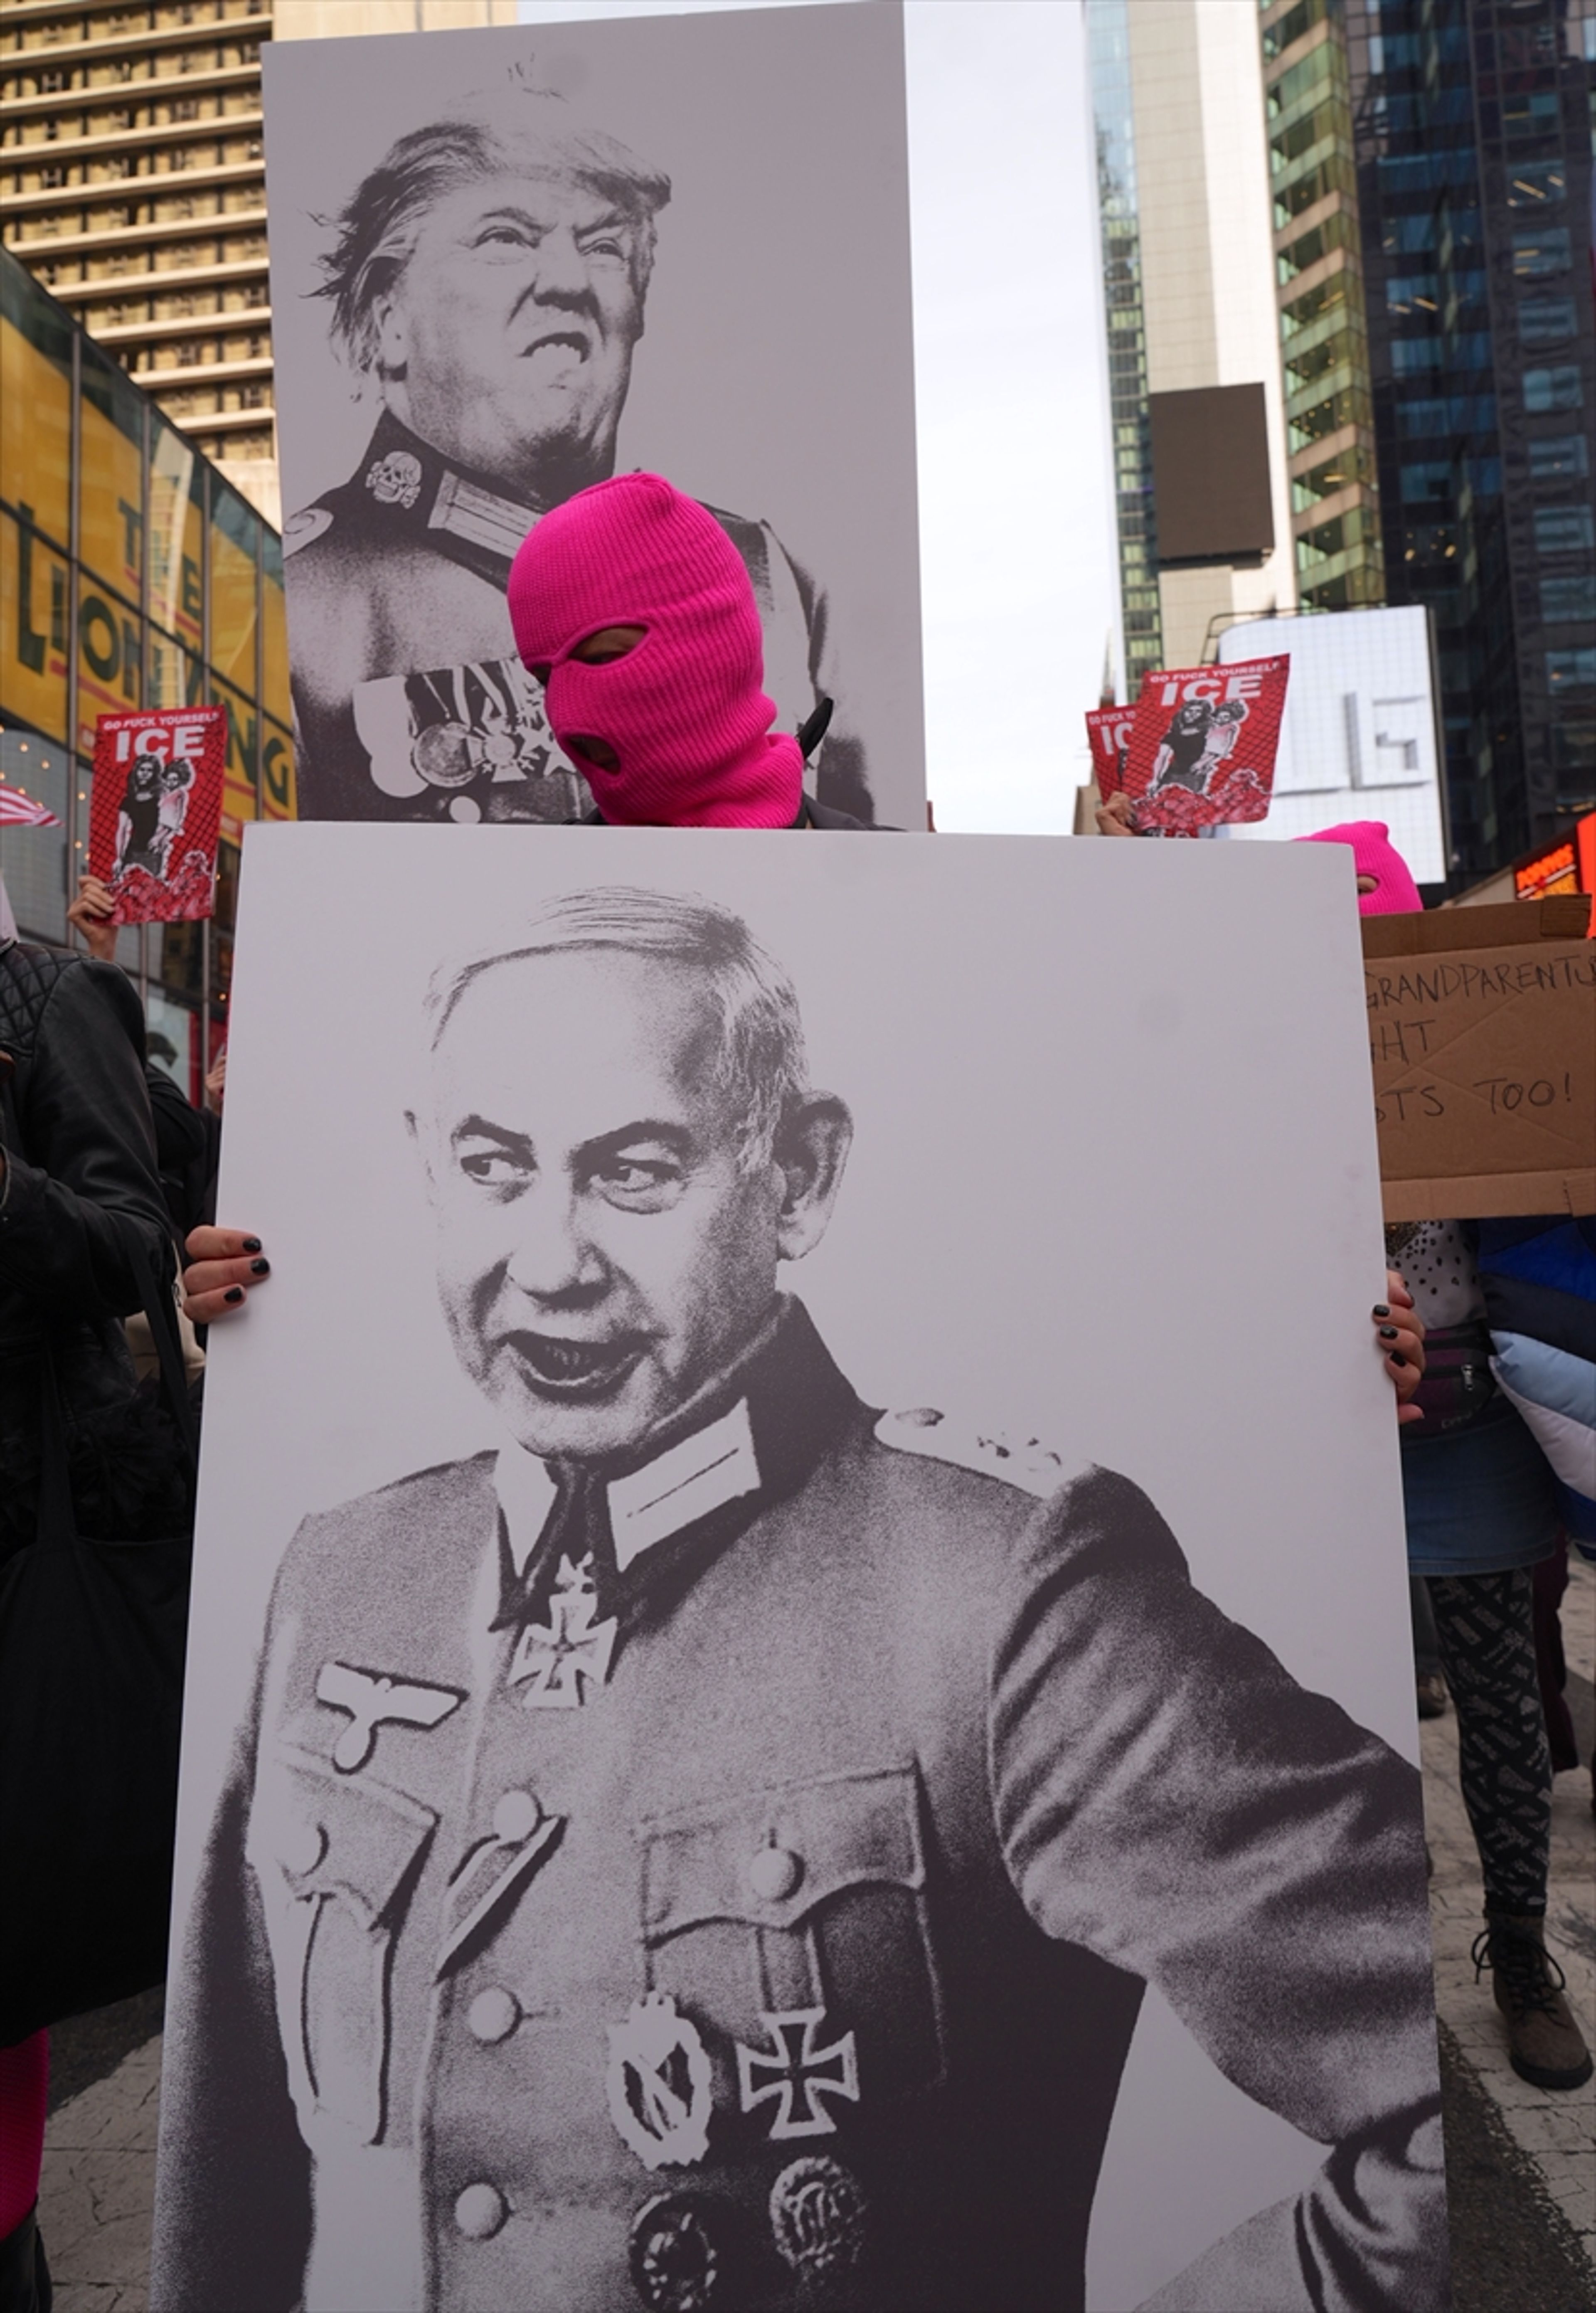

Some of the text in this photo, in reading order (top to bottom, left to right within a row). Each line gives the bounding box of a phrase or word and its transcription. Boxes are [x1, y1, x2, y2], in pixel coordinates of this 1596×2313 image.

[1150, 675, 1169, 683] GO
[1172, 670, 1207, 681] FUCK
[1160, 674, 1264, 707] ICE
[103, 720, 121, 730] GO
[123, 716, 155, 728] FUCK
[1101, 722, 1133, 755] IC
[116, 725, 205, 762] ICE
[1473, 1071, 1571, 1115] TOO!
